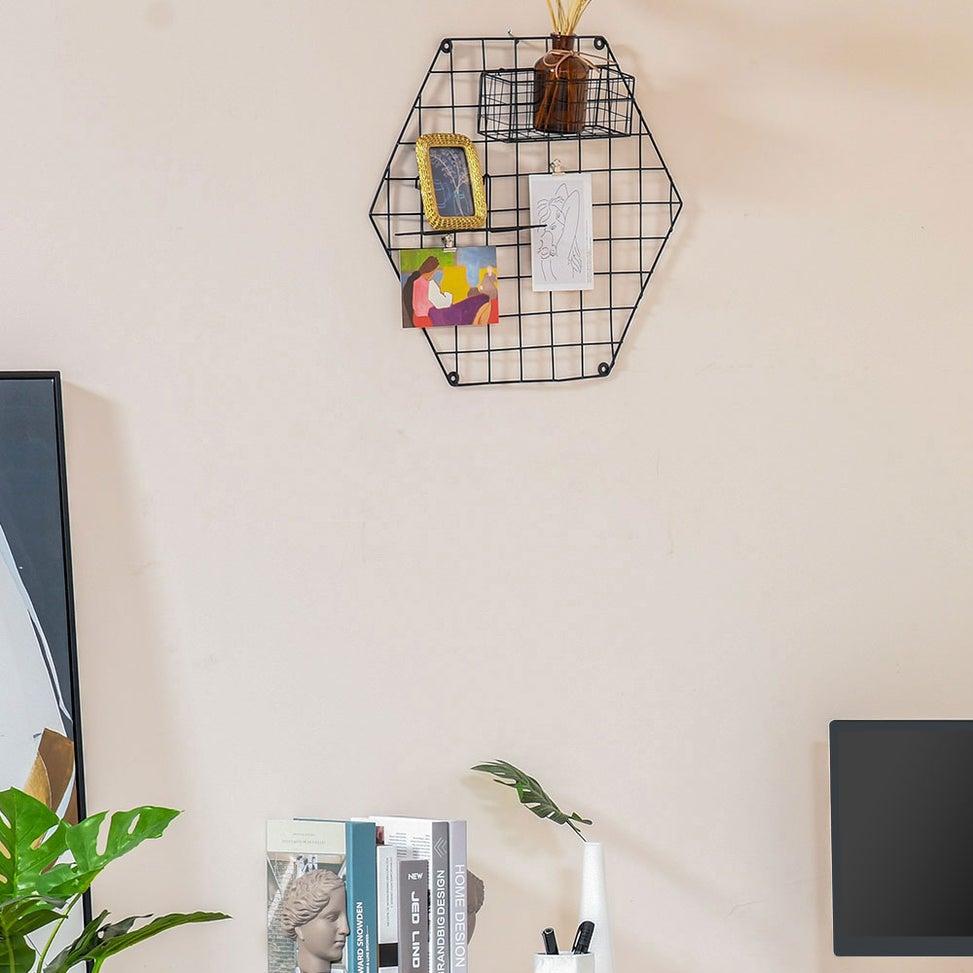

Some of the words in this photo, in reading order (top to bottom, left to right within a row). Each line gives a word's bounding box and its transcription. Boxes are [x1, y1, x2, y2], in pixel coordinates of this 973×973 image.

[436, 870, 445, 915] DESIGN
[455, 864, 465, 908] HOME
[411, 891, 420, 924] JED
[412, 930, 420, 968] LIND
